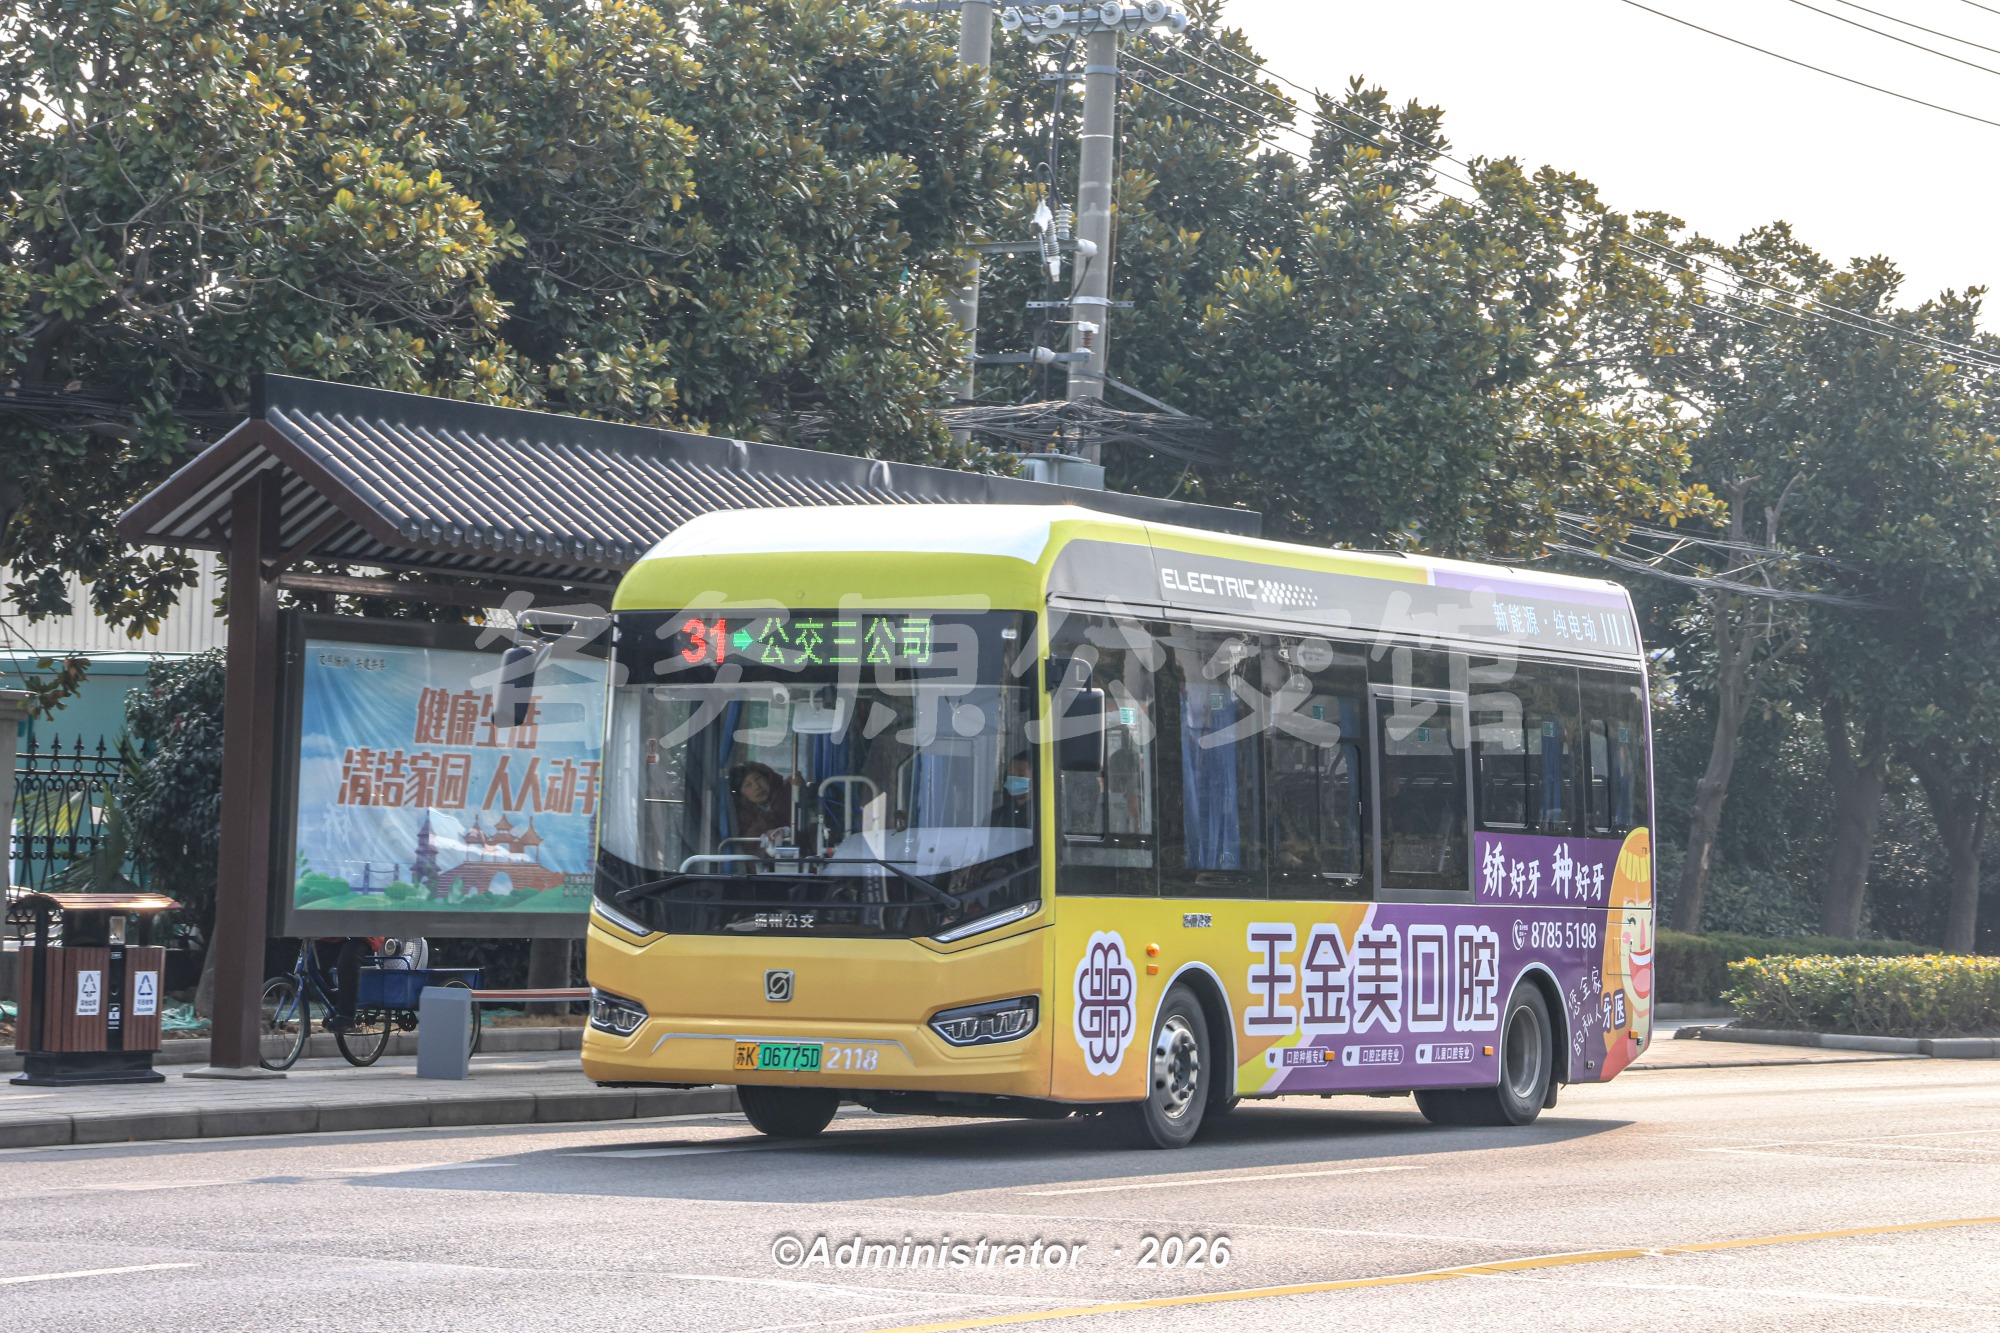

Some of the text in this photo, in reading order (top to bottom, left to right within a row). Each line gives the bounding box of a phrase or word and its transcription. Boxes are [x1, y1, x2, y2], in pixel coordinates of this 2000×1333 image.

[1161, 568, 1258, 600] ELECTRIC
[682, 617, 931, 664] 31 公交三公司
[337, 748, 472, 810] 清洁家园
[1482, 841, 1605, 901] 矫好牙 种好牙
[1531, 921, 1563, 949] 8785
[1565, 922, 1597, 949] 5198
[1247, 932, 1497, 1027] 王金美口腔
[826, 1047, 879, 1071] 2118
